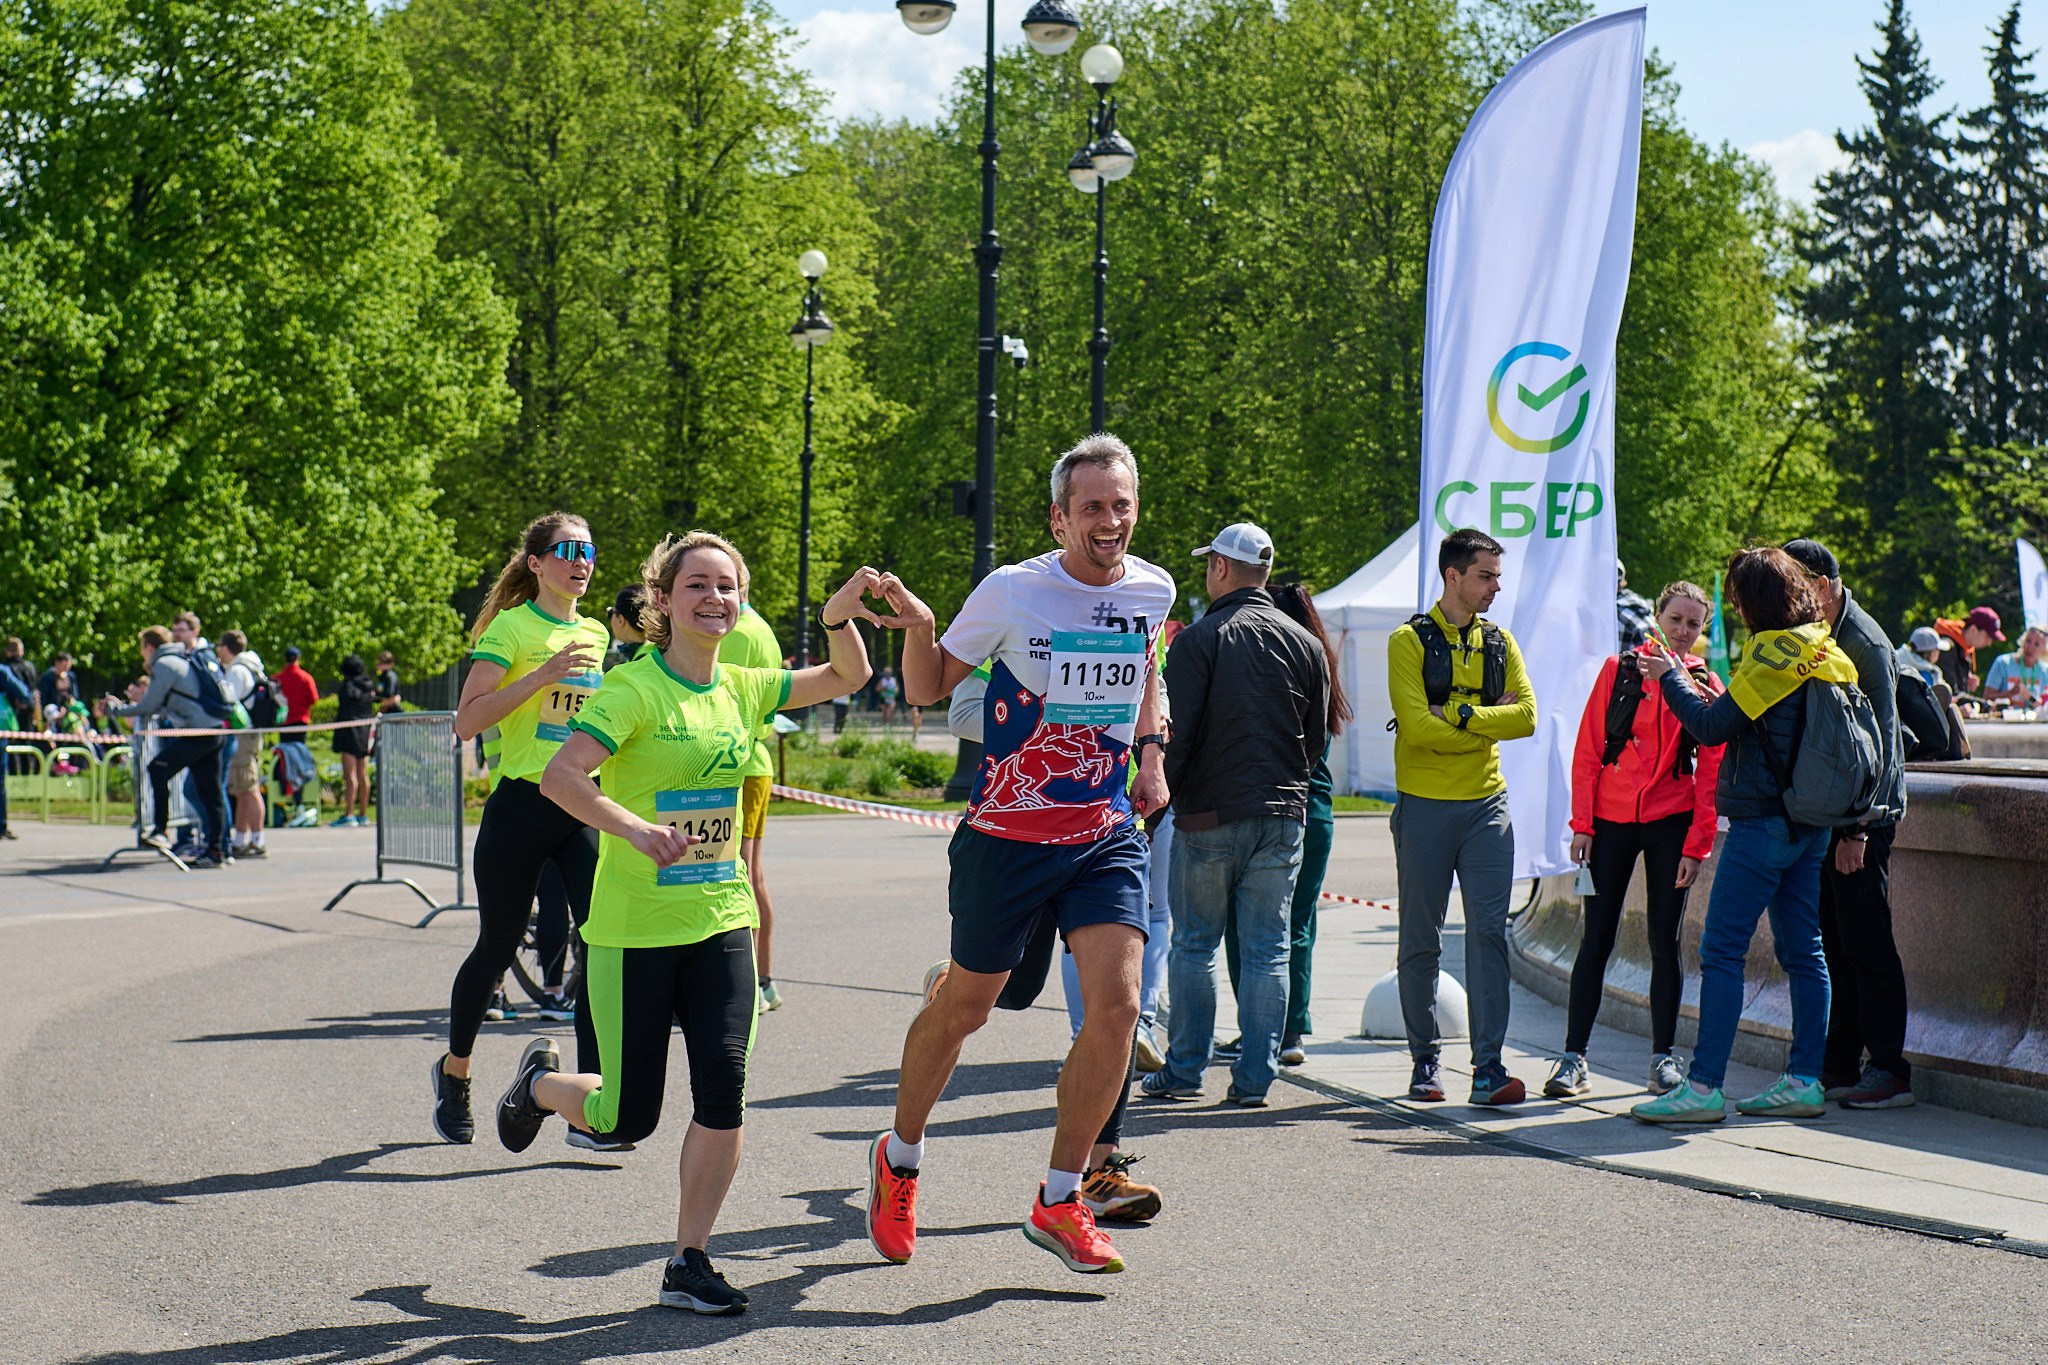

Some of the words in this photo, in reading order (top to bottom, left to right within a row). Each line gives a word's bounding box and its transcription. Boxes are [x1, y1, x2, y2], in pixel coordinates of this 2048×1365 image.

[1435, 480, 1603, 538] СБЕР
[1060, 662, 1137, 687] 11130
[551, 690, 590, 713] 115
